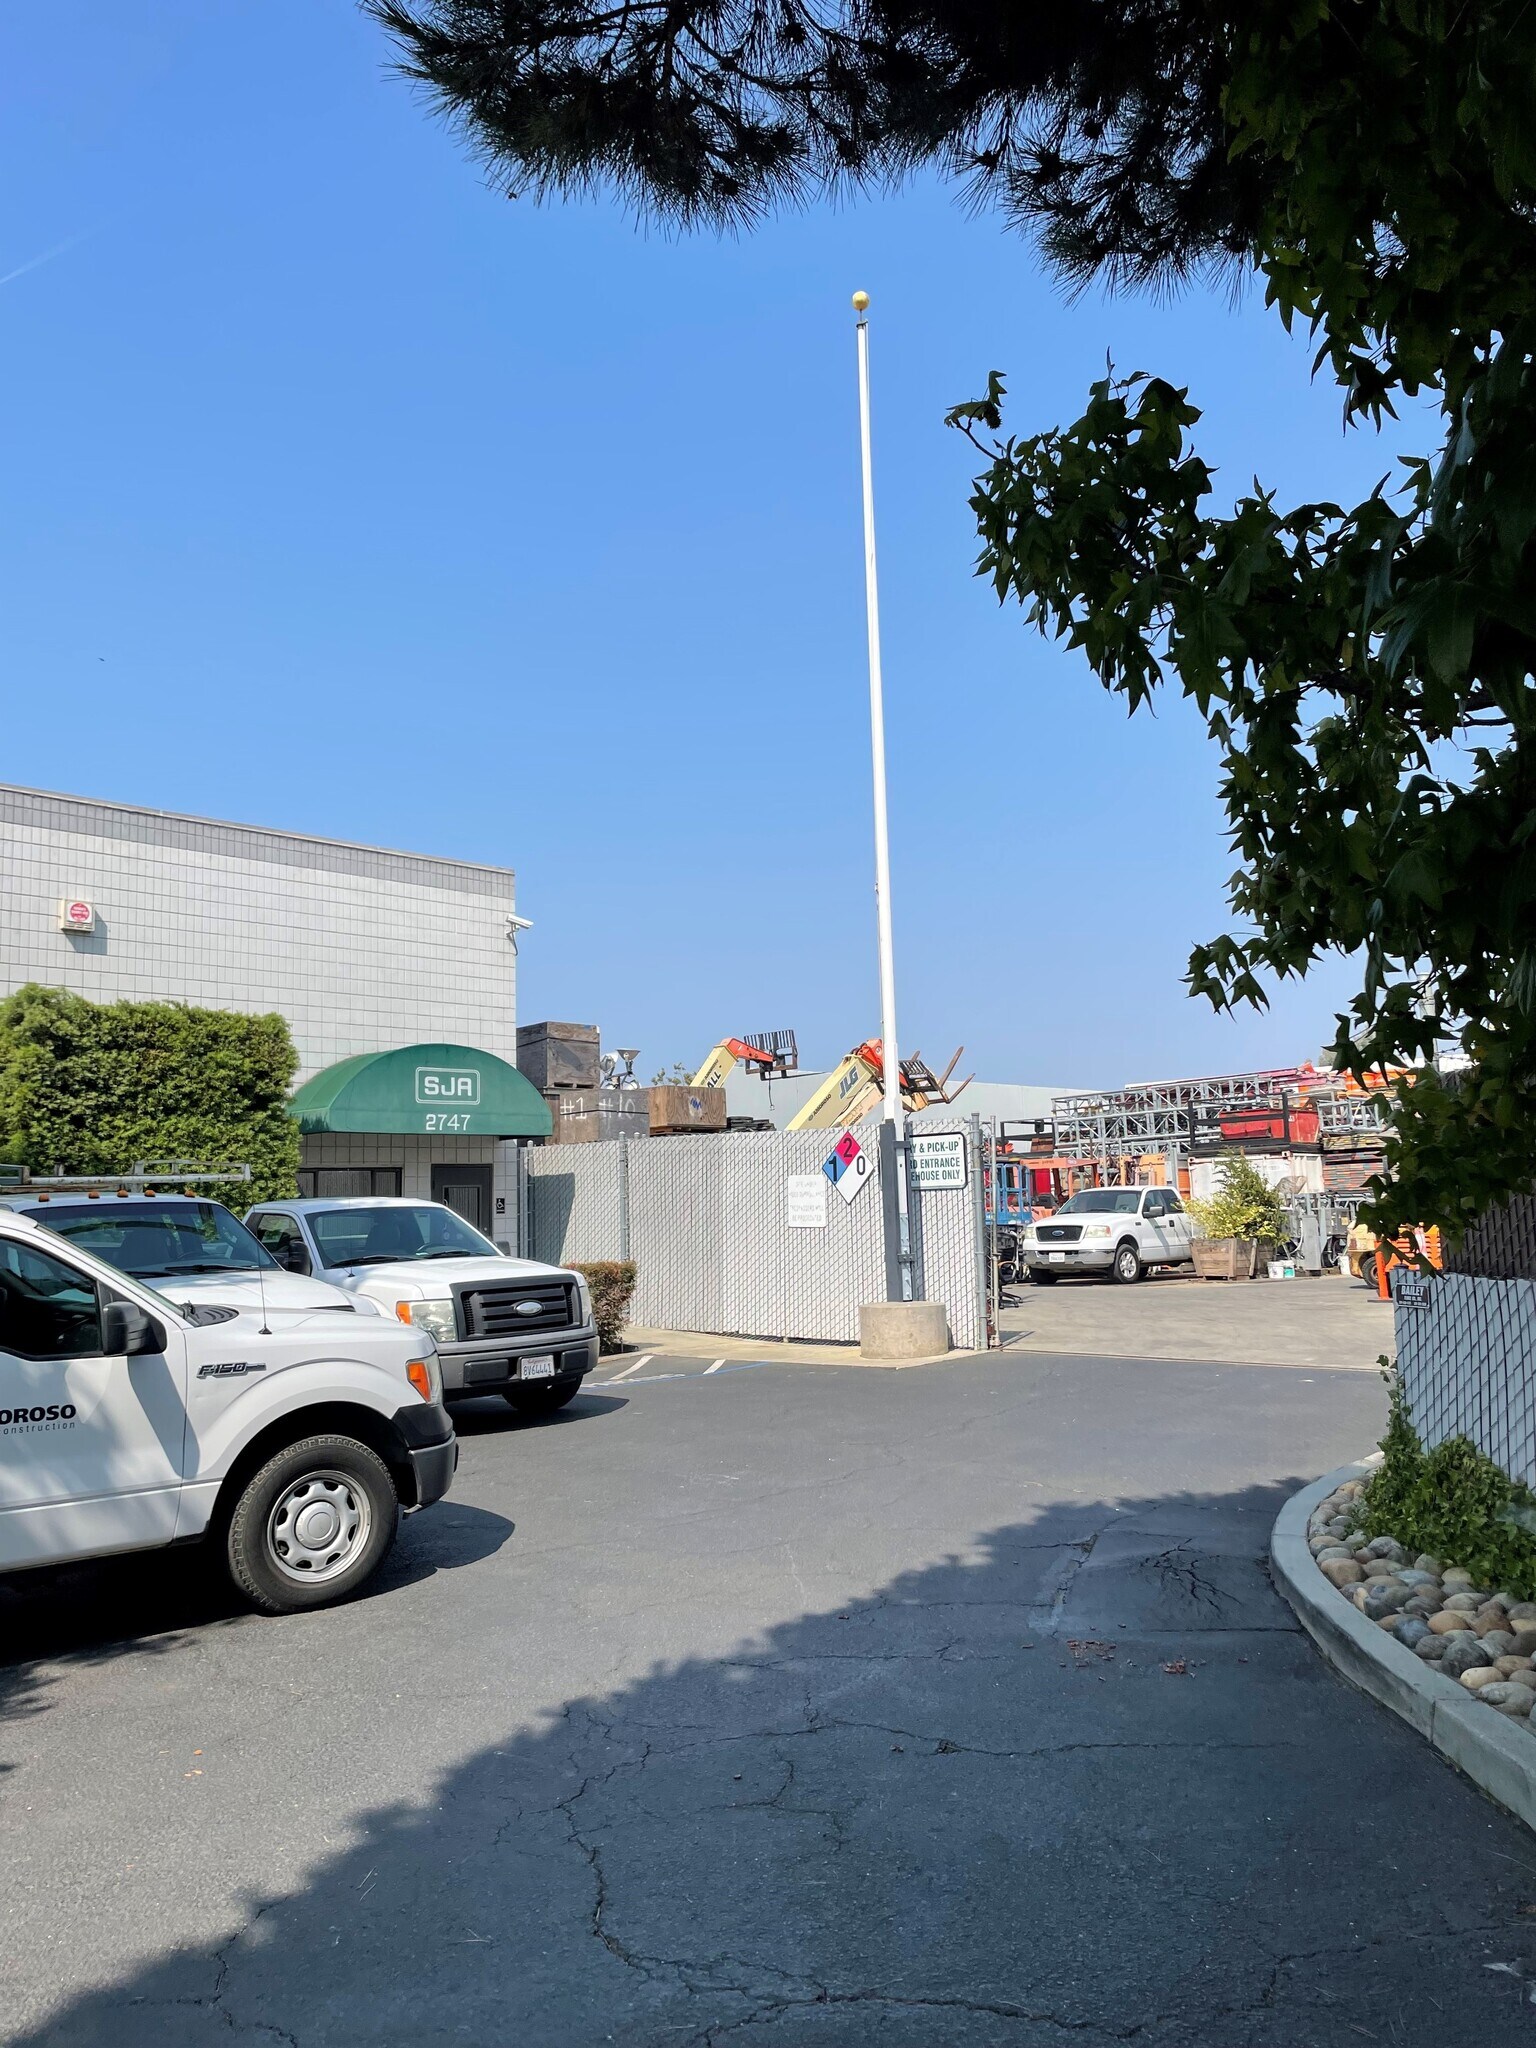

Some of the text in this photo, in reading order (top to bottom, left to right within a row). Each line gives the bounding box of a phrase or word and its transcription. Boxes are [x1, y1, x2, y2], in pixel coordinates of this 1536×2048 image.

[424, 1076, 472, 1096] SJA
[839, 1065, 859, 1100] JLG
[560, 1097, 587, 1121] #1
[813, 1093, 832, 1116] AMOROSO
[425, 1113, 471, 1131] 2747
[843, 1137, 852, 1158] 2
[919, 1143, 925, 1153] &
[927, 1141, 959, 1153] PICK-UP
[828, 1156, 838, 1182] 1
[856, 1155, 866, 1176] 0
[920, 1157, 960, 1169] ENTRANCE
[941, 1169, 960, 1180] ONLY
[1401, 1285, 1425, 1296] BAILEY
[0, 1404, 77, 1425] OROSO
[0, 1422, 76, 1435] onstruction
